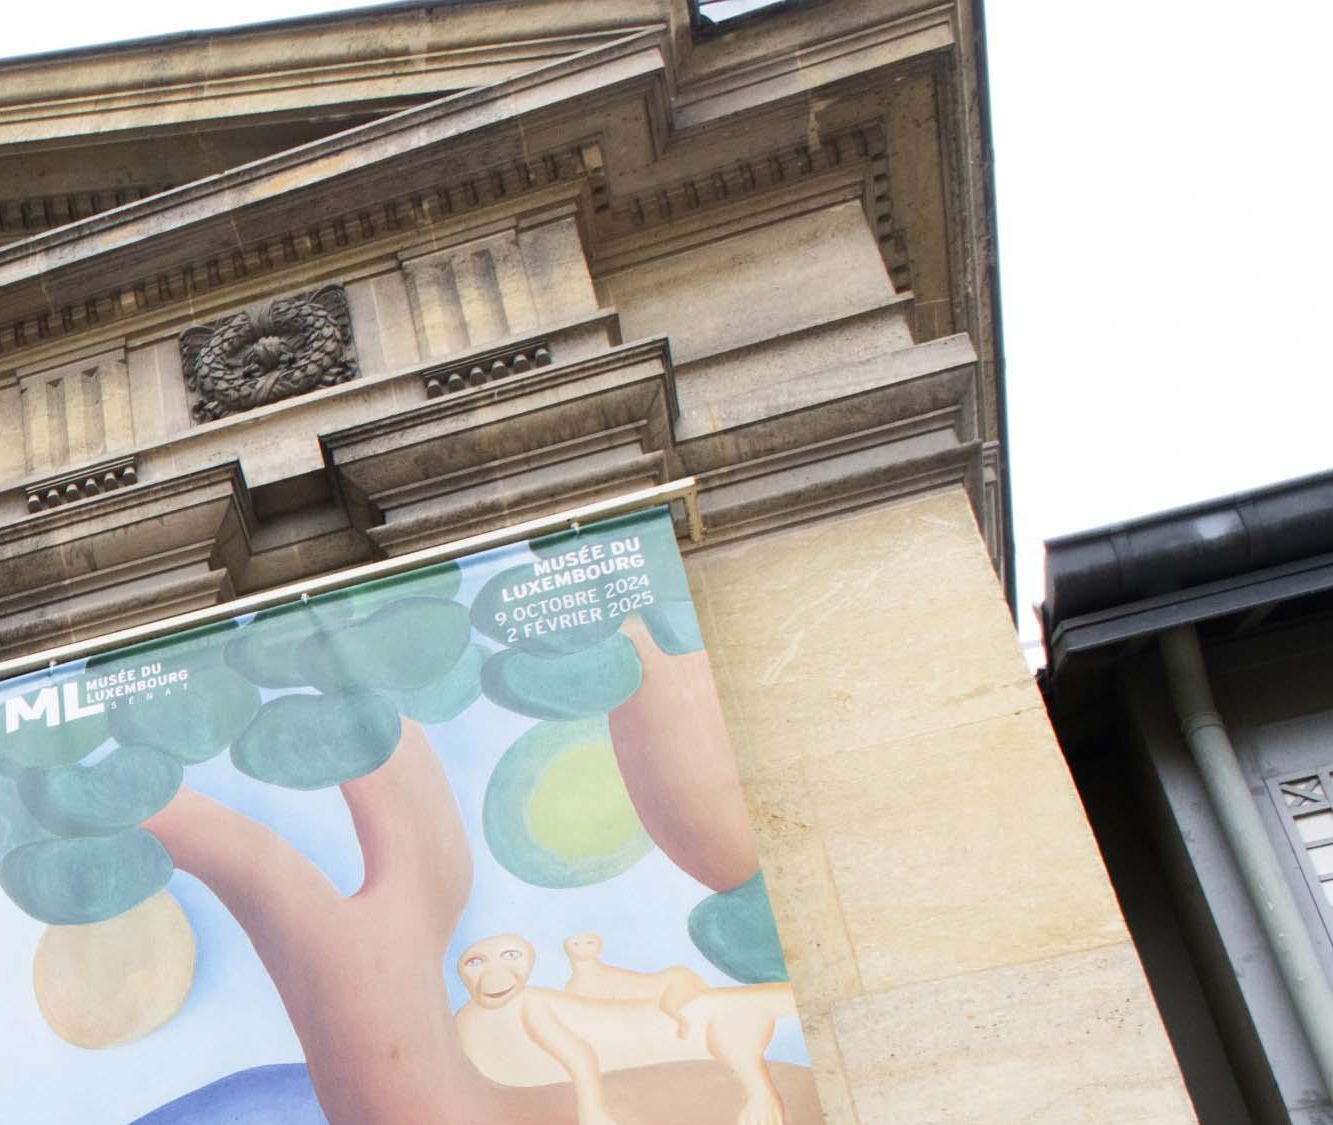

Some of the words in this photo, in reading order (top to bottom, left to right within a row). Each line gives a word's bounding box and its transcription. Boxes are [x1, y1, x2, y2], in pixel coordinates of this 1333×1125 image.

[501, 554, 646, 602] LUXEMBOURG
[533, 544, 604, 577] MUSÉE
[612, 536, 642, 557] DU
[495, 611, 505, 626] 9
[513, 589, 598, 622] OCTOBRE
[604, 575, 649, 599] 2024
[506, 627, 518, 643] 2
[523, 607, 602, 639] FÉVRIER
[608, 591, 654, 618] 2025
[85, 669, 136, 691] MUSÉE
[141, 662, 162, 678] DU
[86, 669, 189, 705] LUXEMBOURG
[5, 682, 105, 734] ML
